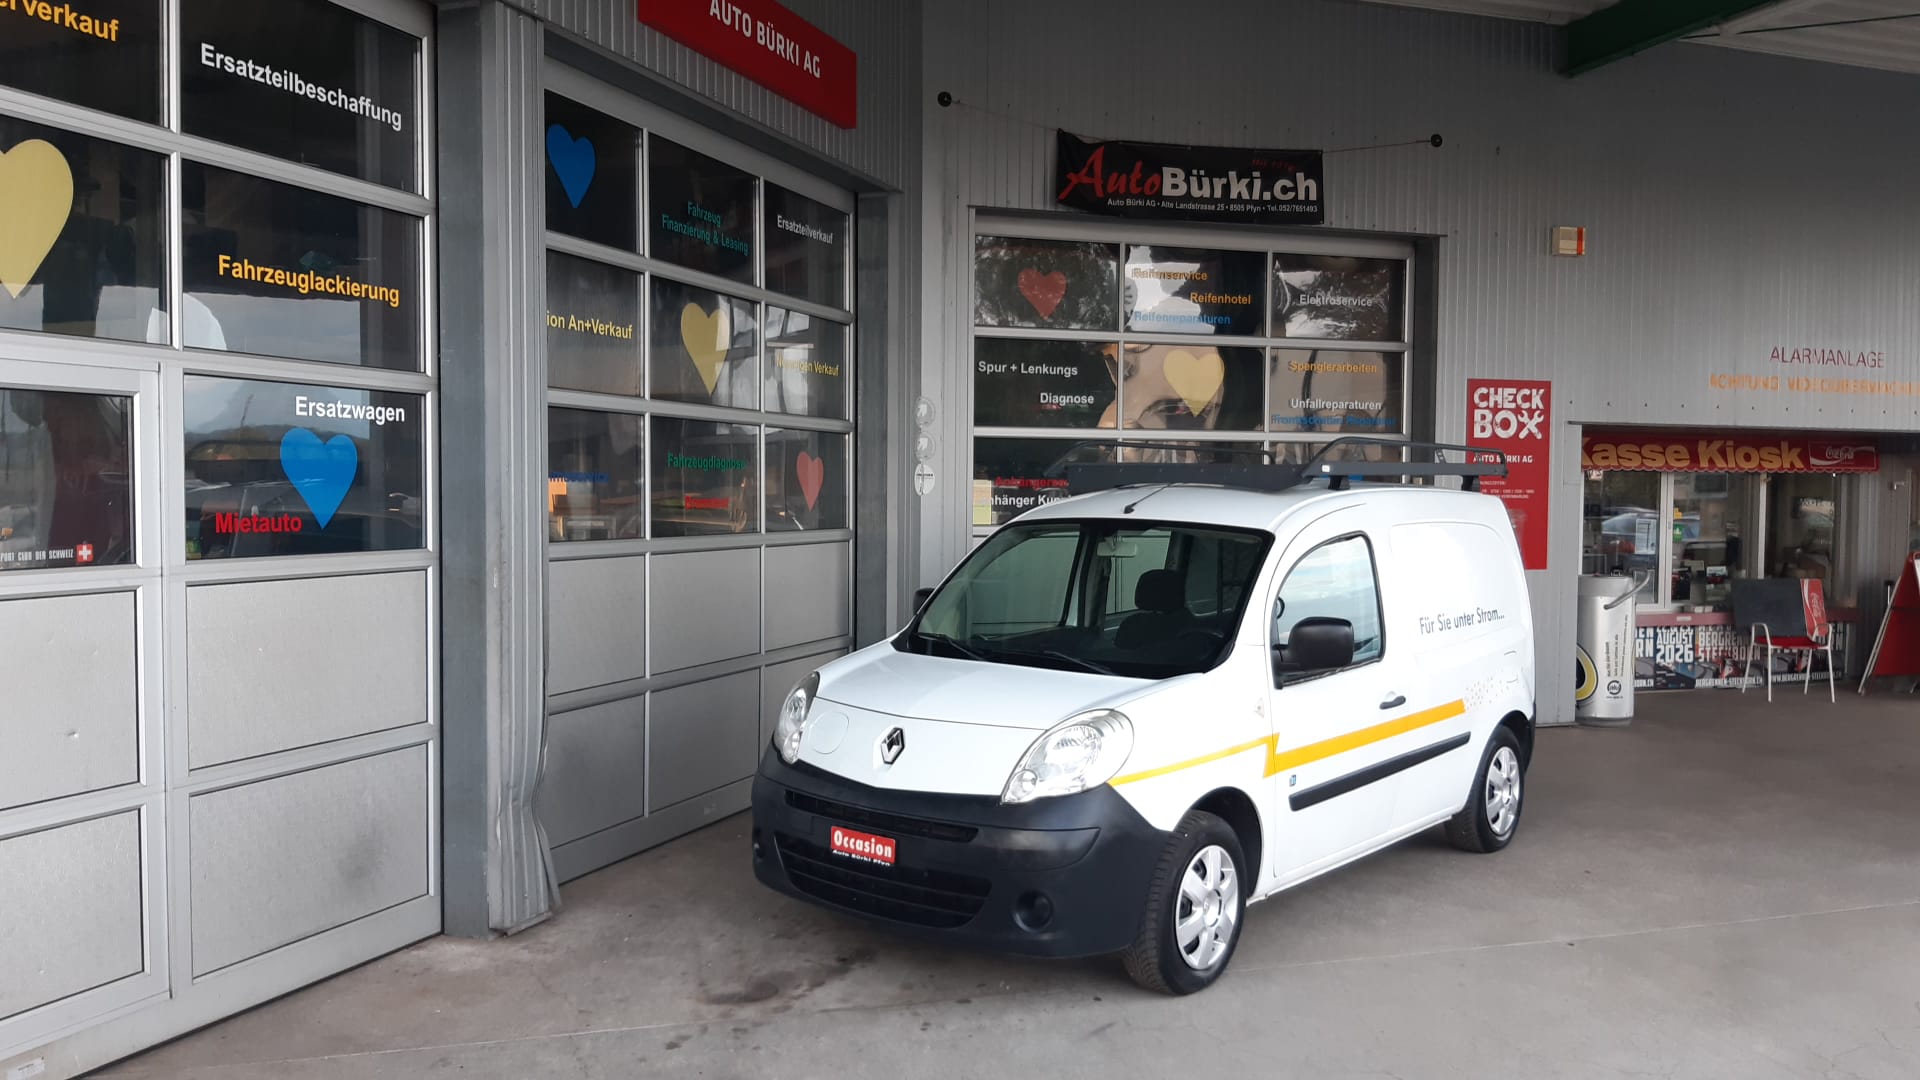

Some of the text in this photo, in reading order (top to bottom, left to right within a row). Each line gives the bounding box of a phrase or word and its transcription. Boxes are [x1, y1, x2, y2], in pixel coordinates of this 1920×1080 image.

[709, 0, 820, 78] AUTO BÜRKI AG
[201, 42, 402, 131] Ersatzteilbeschaffung
[1107, 198, 1125, 206] Auto
[687, 200, 721, 228] Fahrzeug
[662, 213, 749, 257] Finanzierung & Leasing
[777, 215, 834, 245] Ersatzteilverkauf
[218, 254, 400, 308] Fahrzeuglackierung
[1190, 292, 1252, 305] Reifenhotel
[1299, 293, 1373, 307] Elektroservice
[568, 314, 633, 339] An+Verkauf
[978, 360, 1079, 377] Spur + Lenkungs
[1288, 360, 1378, 374] Spenglerarbeiten
[1769, 346, 1885, 369] ALARMANLAGE
[1709, 373, 1781, 391] ACHTUNG
[1040, 392, 1094, 407] Diagnose
[1289, 398, 1382, 411] Unfallreparaturen
[1473, 386, 1545, 410] CHECK
[295, 396, 405, 425] Ersatzwagen
[1473, 409, 1545, 439] BOX
[667, 452, 747, 472] Fahrzeugdiagnose
[1496, 454, 1520, 463] BRKI
[1522, 455, 1533, 463] AG
[1698, 440, 1805, 468] Kiosk
[215, 512, 302, 534] Mietauto
[1419, 607, 1505, 635] Für Sie unter Strom...
[1656, 630, 1694, 645] AUGUST
[1656, 645, 1694, 664] 2026
[834, 830, 892, 858] Occasion
